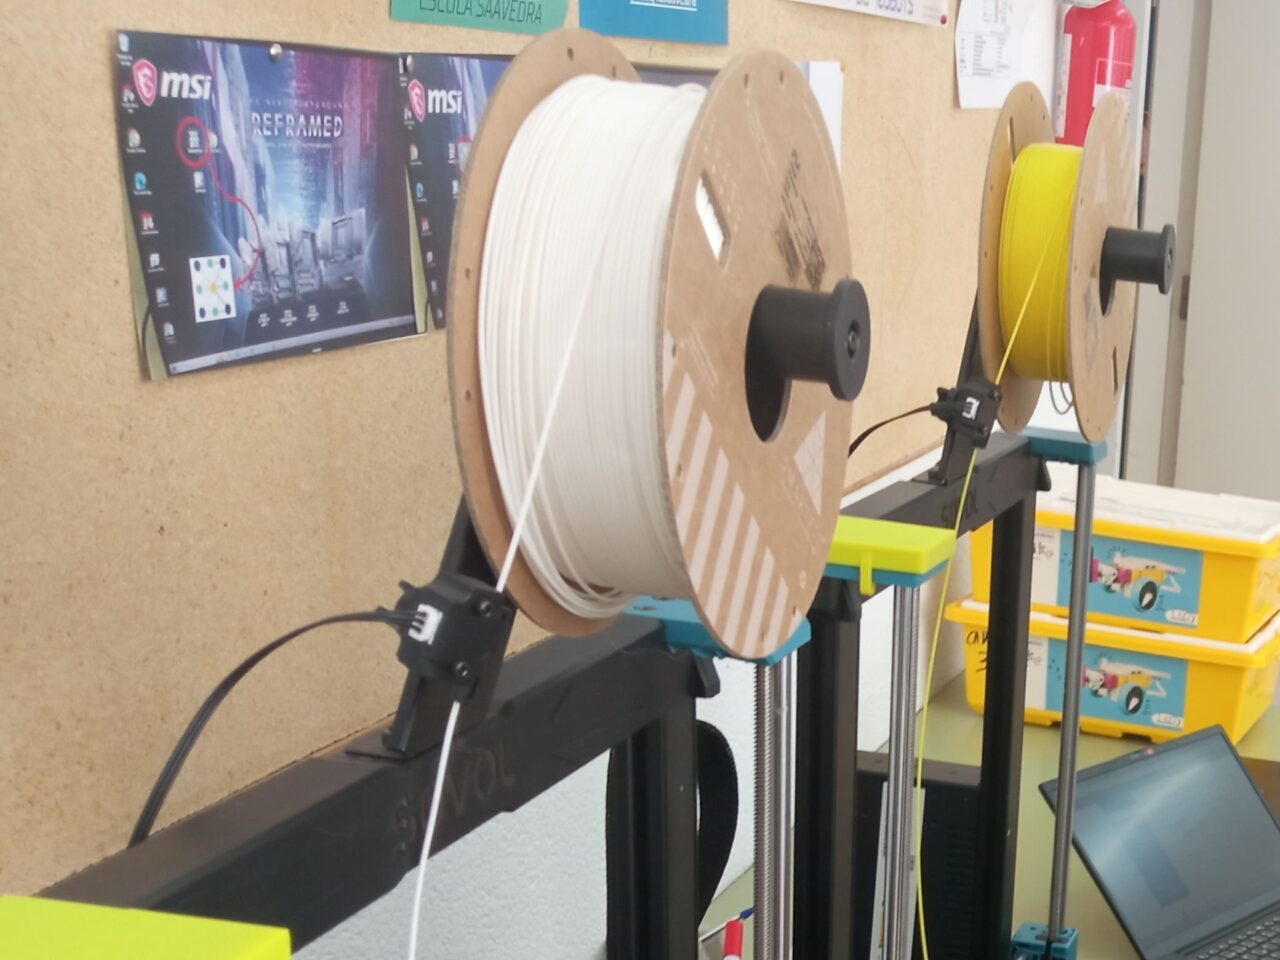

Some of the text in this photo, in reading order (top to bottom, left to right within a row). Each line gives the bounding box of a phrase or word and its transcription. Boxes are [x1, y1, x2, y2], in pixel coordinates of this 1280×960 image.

[419, 0, 542, 25] ESCOLA SAAVEDRA
[160, 70, 212, 101] msi
[427, 88, 464, 115] msi
[251, 111, 344, 138] REFRAMED
